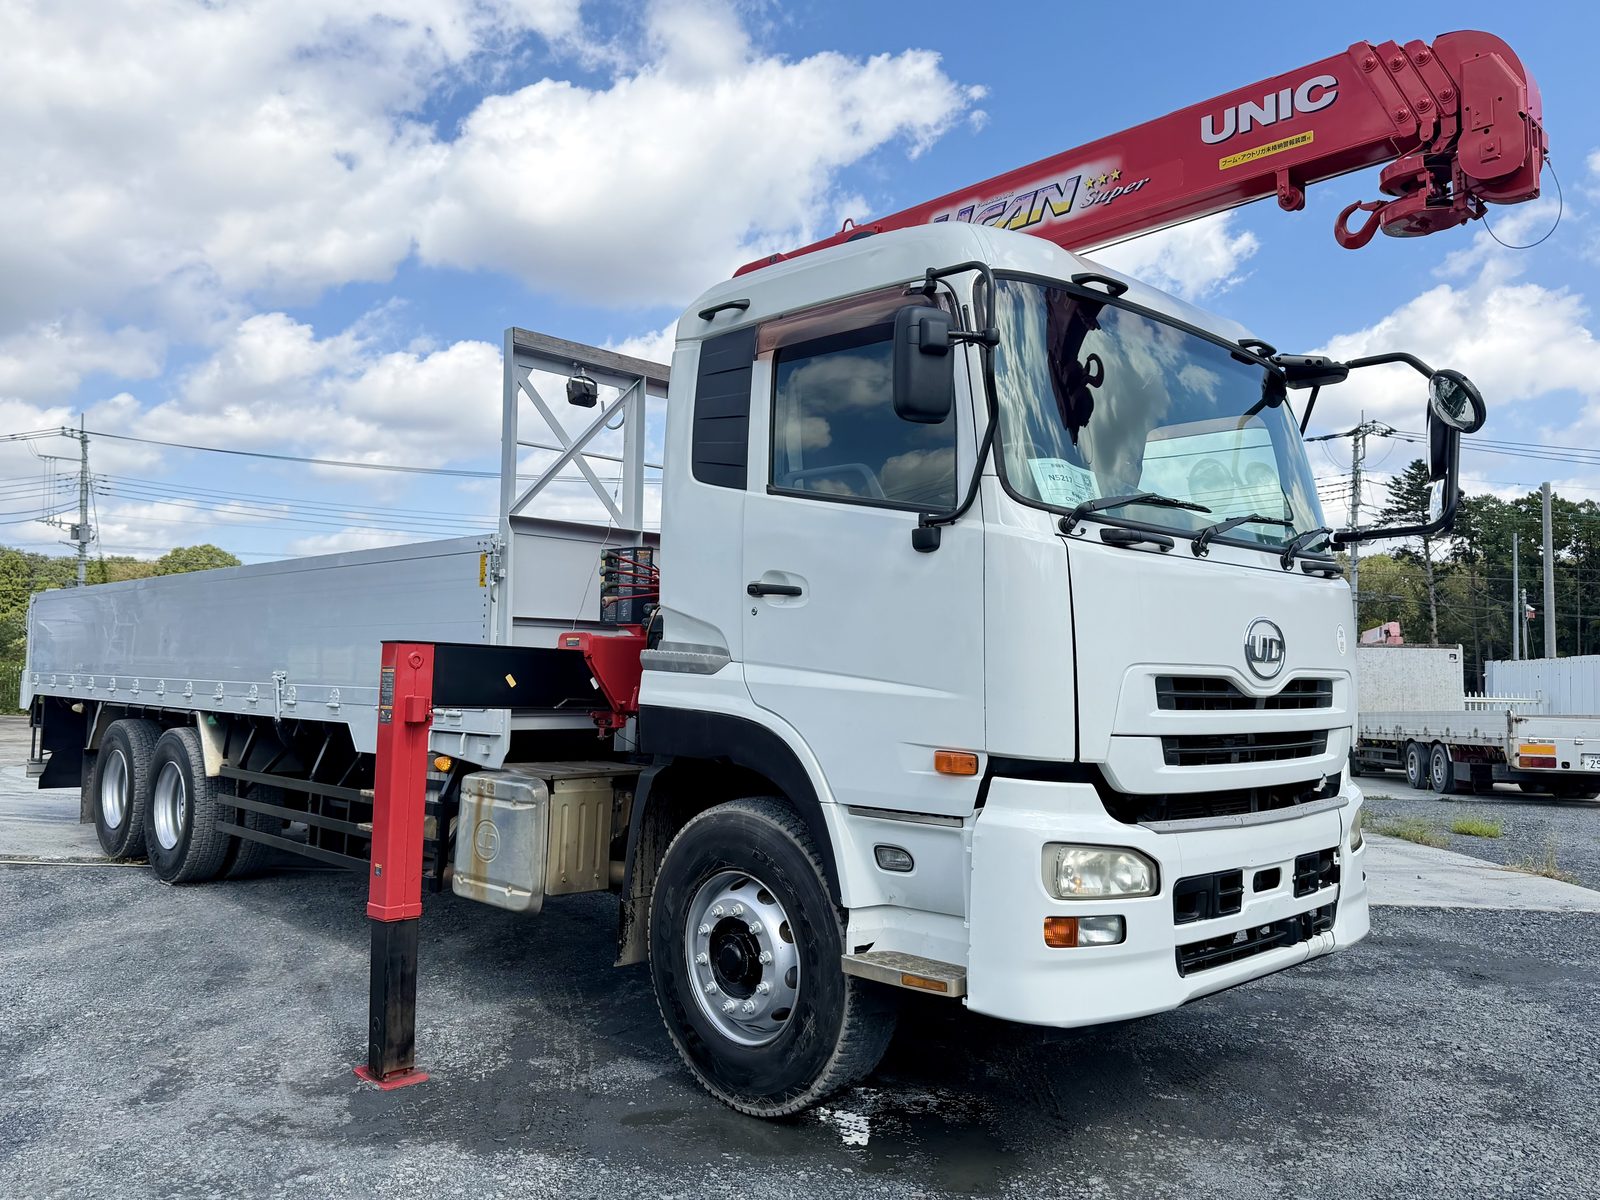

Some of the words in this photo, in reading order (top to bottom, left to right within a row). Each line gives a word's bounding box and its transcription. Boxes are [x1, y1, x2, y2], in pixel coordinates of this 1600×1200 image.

[1201, 75, 1339, 145] UNIC
[934, 175, 1081, 231] CAN
[1080, 177, 1150, 209] Super
[1249, 634, 1283, 663] UD
